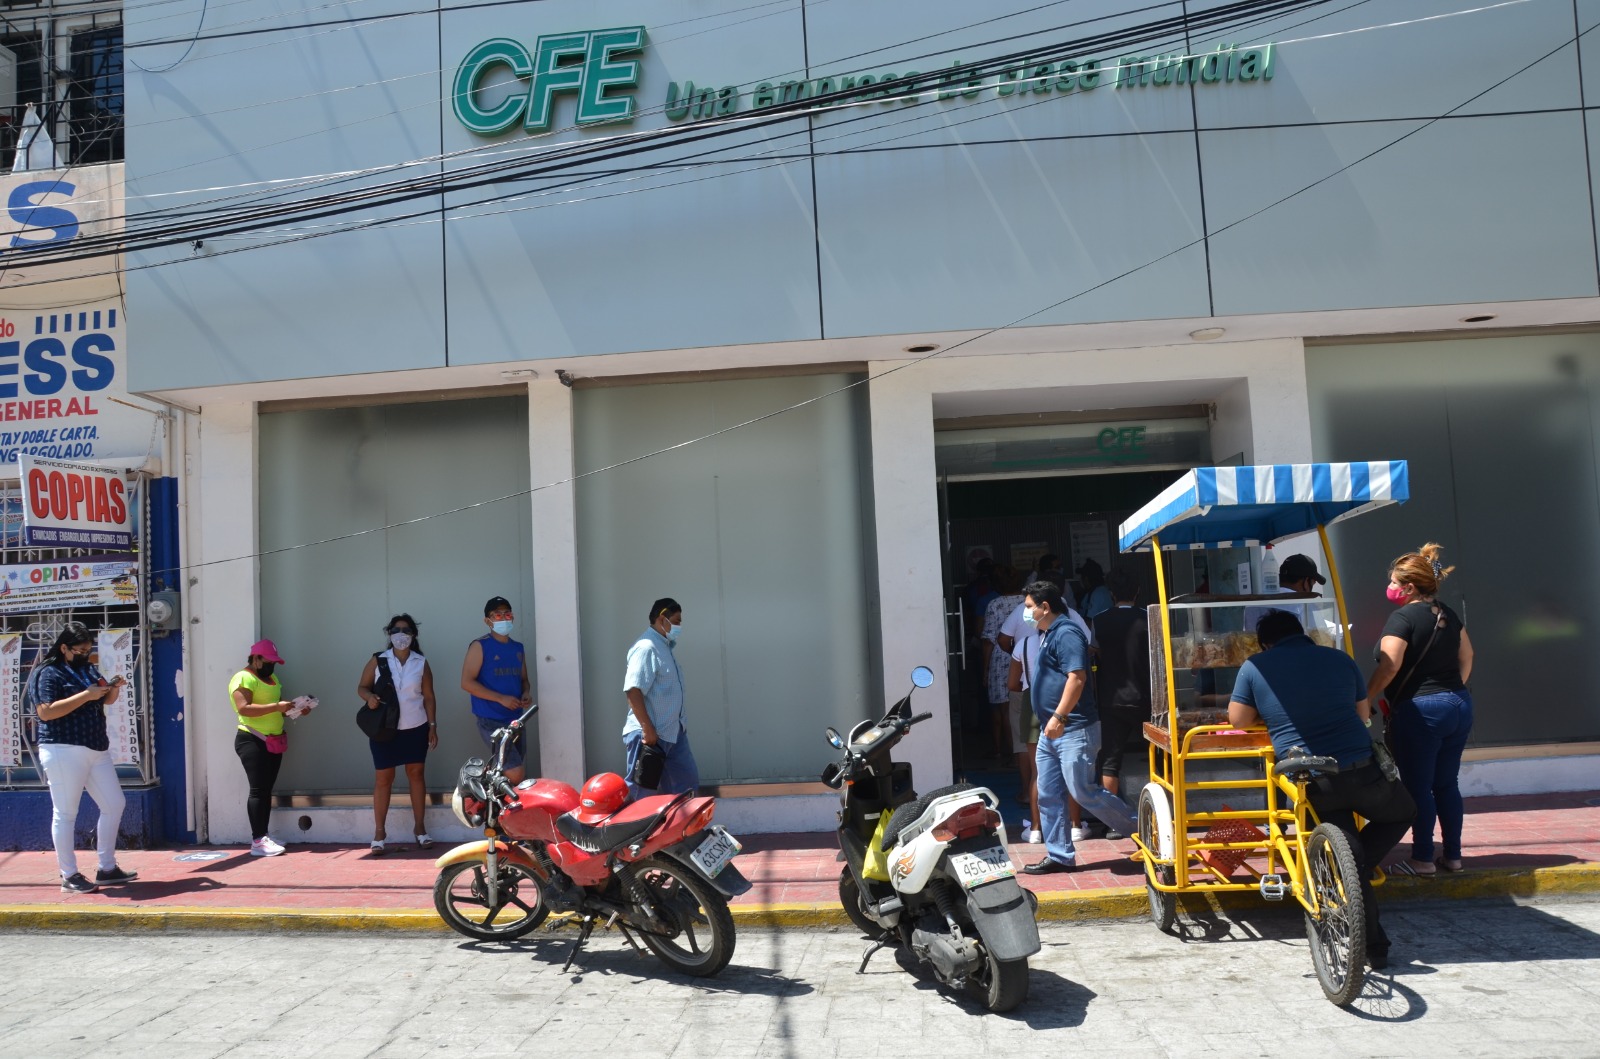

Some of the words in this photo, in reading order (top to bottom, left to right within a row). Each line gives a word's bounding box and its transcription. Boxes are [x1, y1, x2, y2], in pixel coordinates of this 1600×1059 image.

[452, 26, 645, 136] CFE
[665, 79, 738, 121] Una
[997, 56, 1101, 96] clase
[1115, 42, 1277, 89] mundial
[0, 396, 98, 422] ENERAL
[21, 429, 58, 444] DOBLE
[1097, 426, 1147, 452] CFE
[34, 459, 63, 468] SERVICIO
[29, 468, 126, 525] COPIAS
[21, 564, 80, 584] COPIAS
[125, 654, 137, 763] ENGARGOLADOS
[702, 836, 733, 868] 63CSN2
